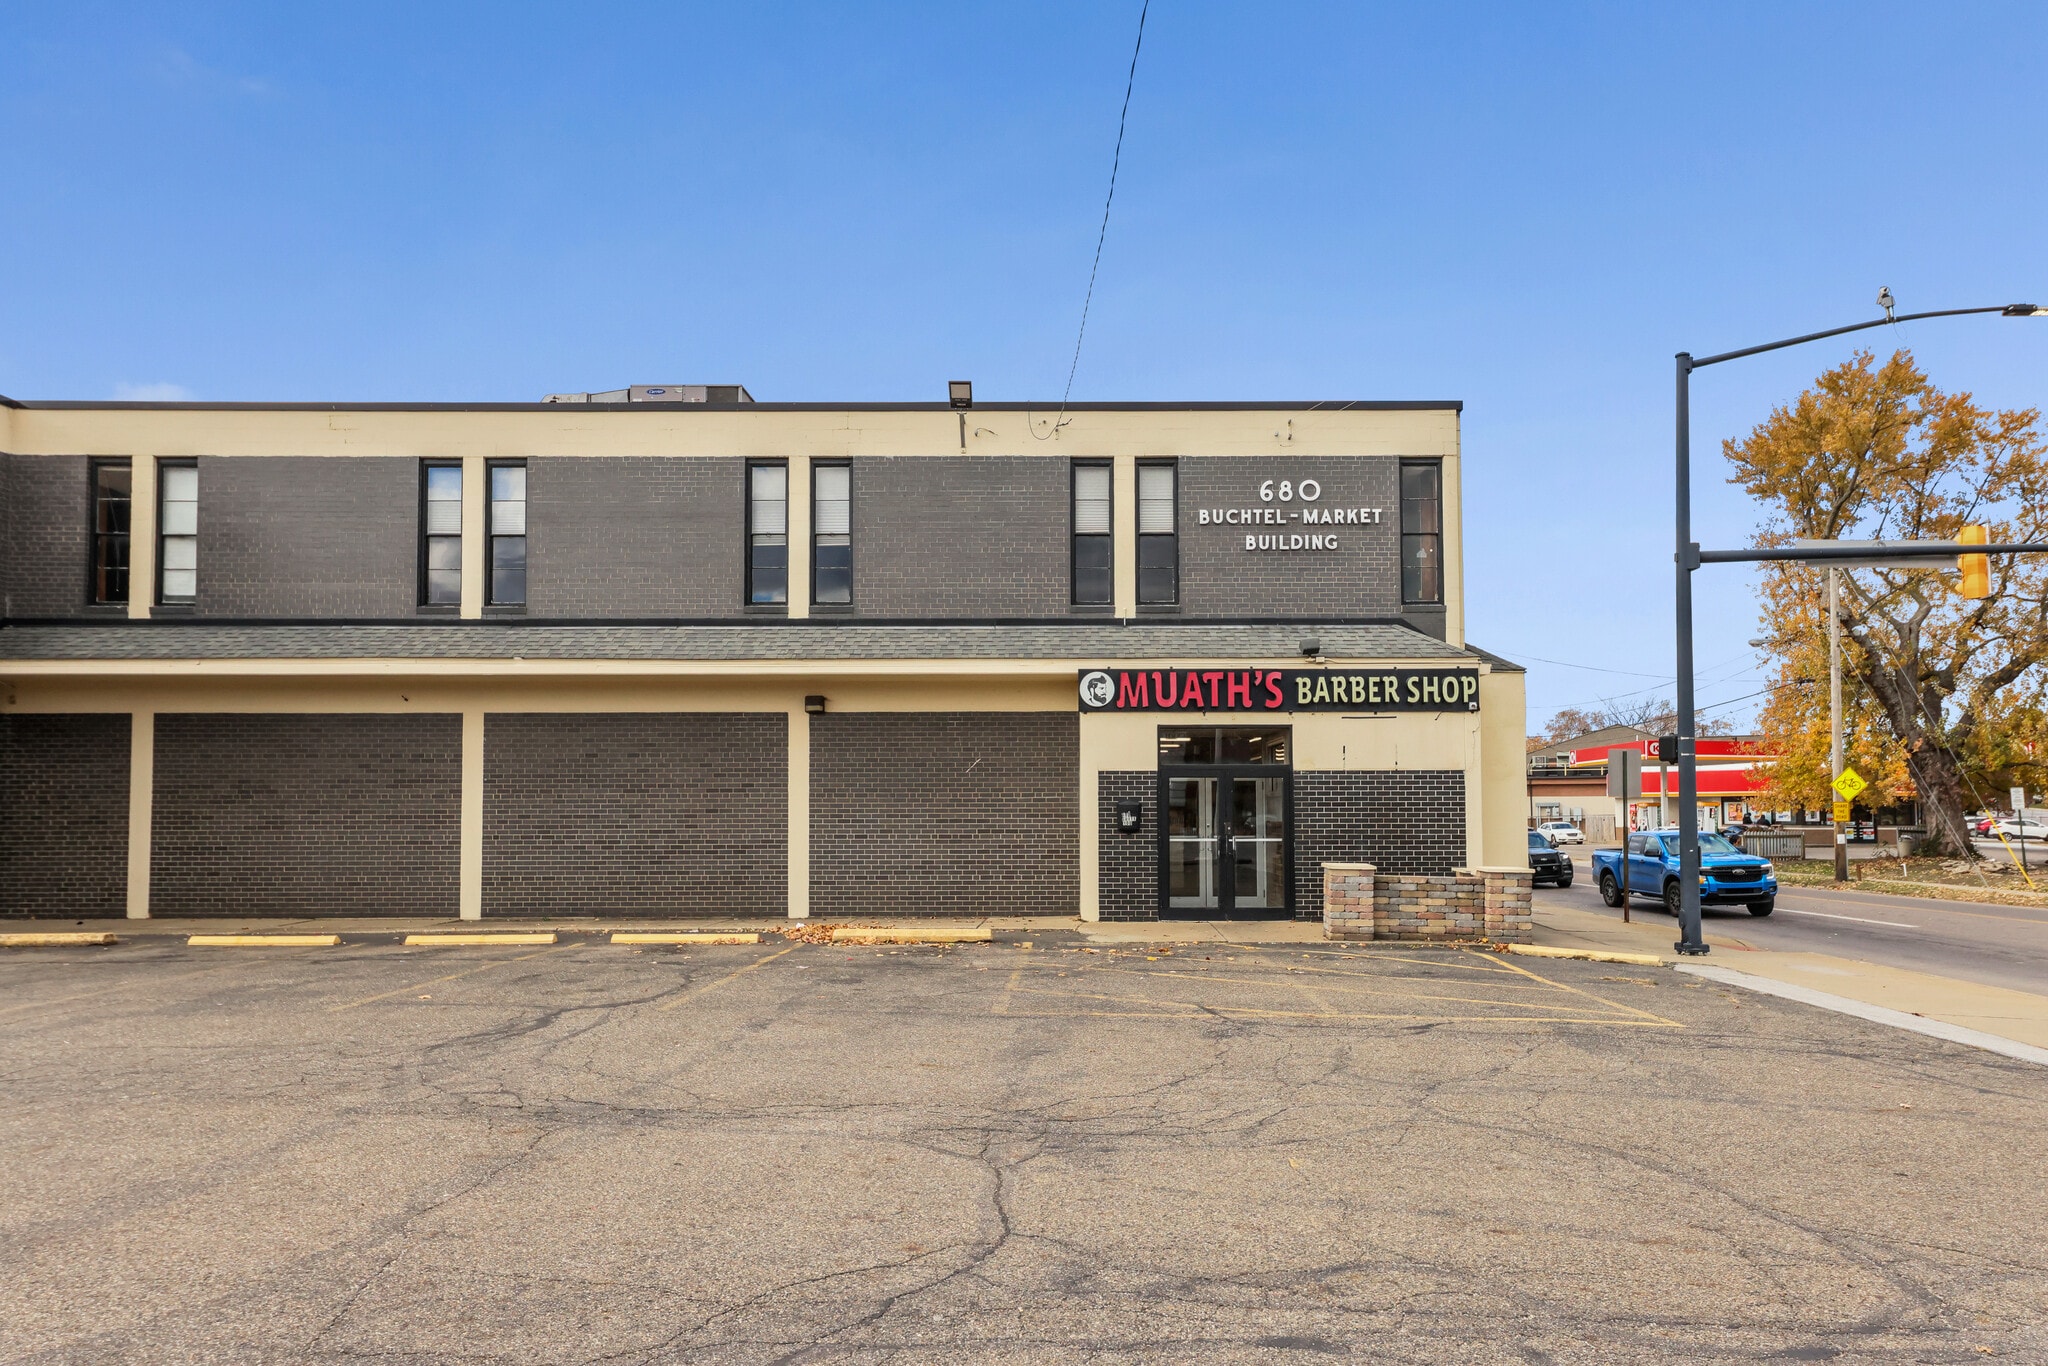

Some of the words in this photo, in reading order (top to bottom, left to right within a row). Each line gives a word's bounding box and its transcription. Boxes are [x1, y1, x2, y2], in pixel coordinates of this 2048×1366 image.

[1259, 479, 1321, 502] 680
[1245, 534, 1338, 551] BUILDING
[1116, 670, 1284, 709] MUATH'S
[1295, 675, 1400, 705] BARBER
[1406, 675, 1477, 704] SHOP
